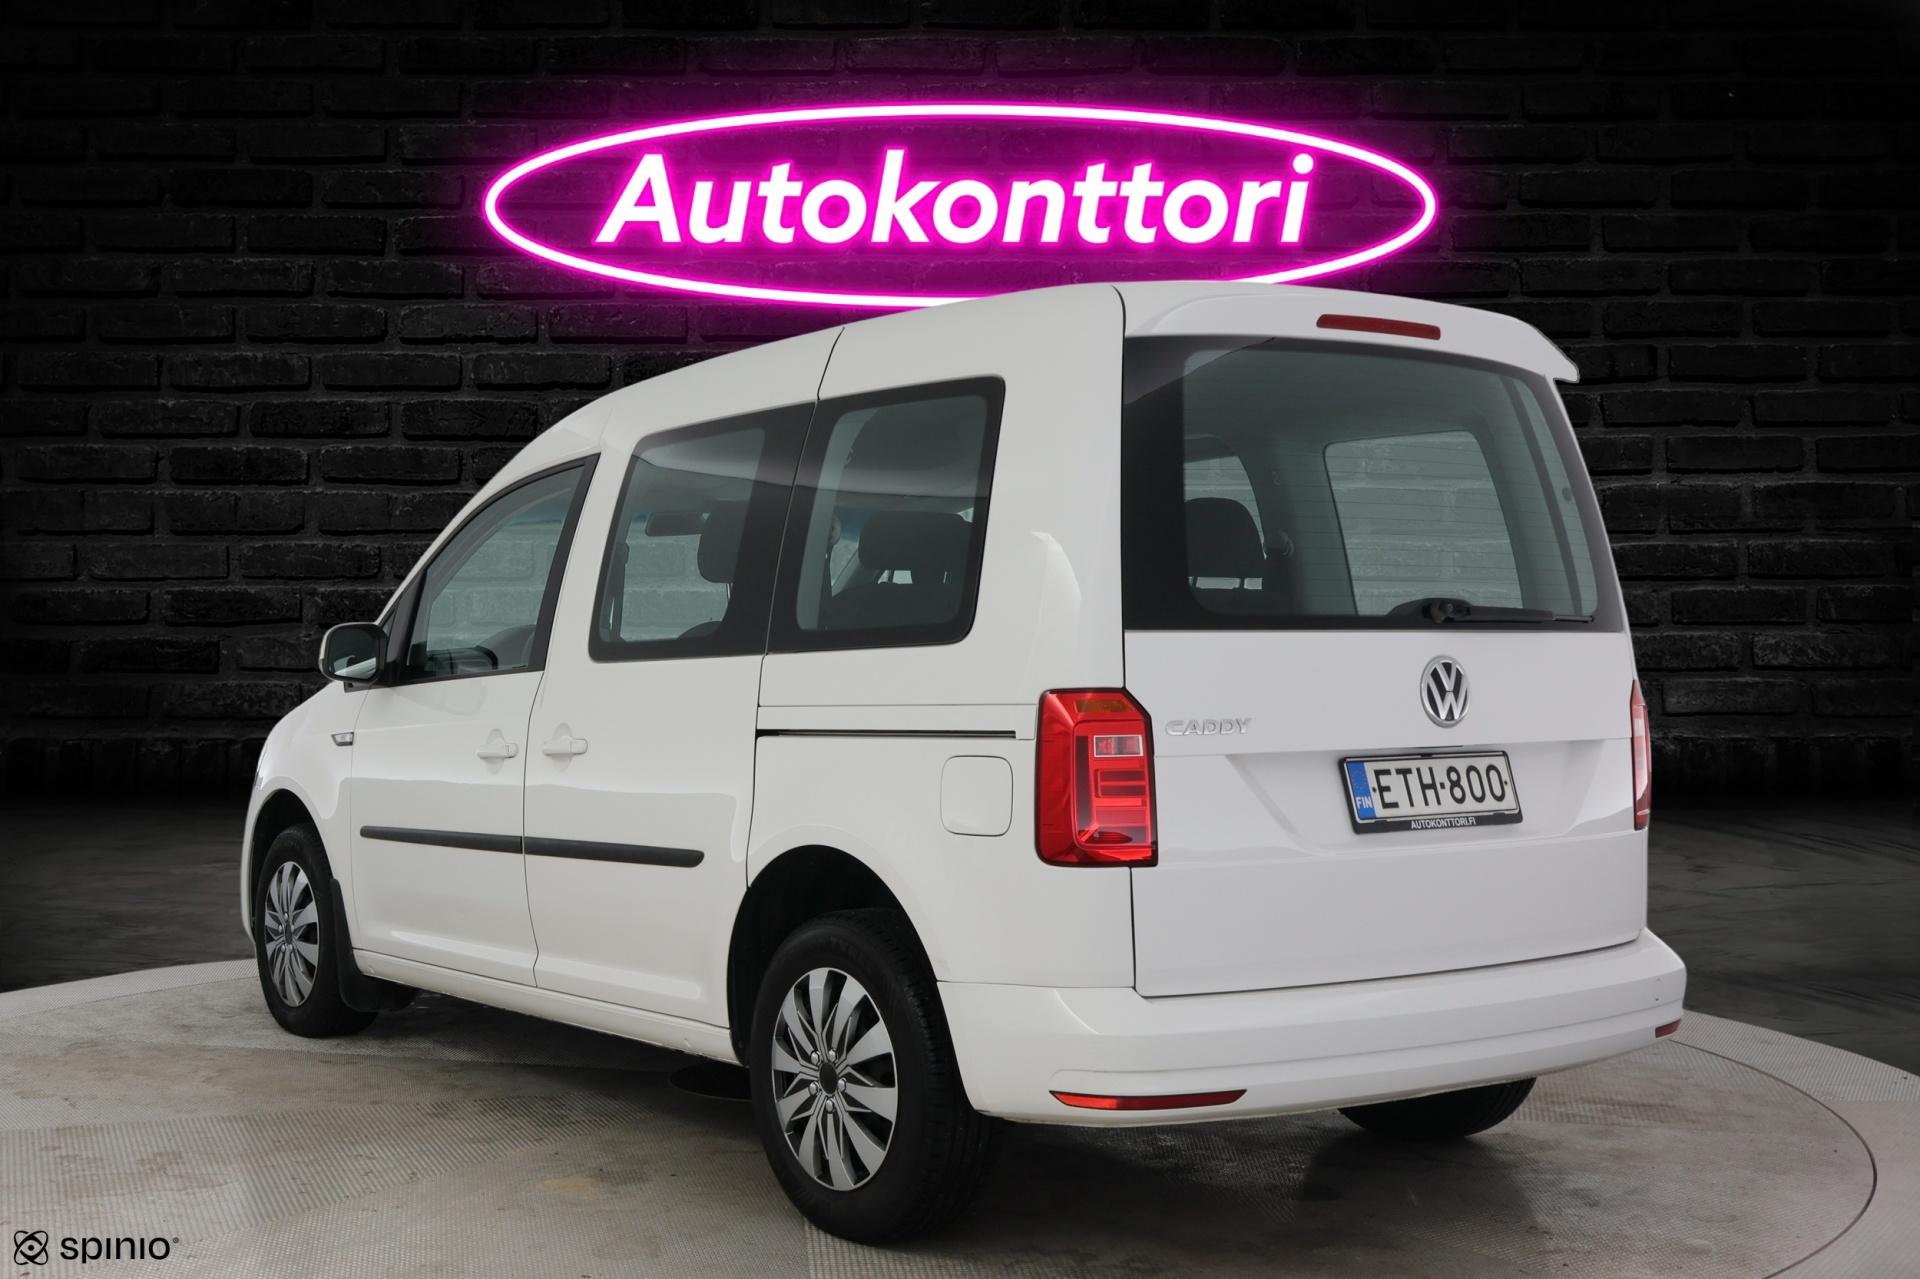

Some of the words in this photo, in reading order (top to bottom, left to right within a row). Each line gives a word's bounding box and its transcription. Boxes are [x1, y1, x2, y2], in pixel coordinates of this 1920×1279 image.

[594, 149, 1315, 244] Autokonttori
[1165, 718, 1252, 736] CADDY
[1373, 764, 1507, 809] ETH-800
[1355, 796, 1373, 809] FIN
